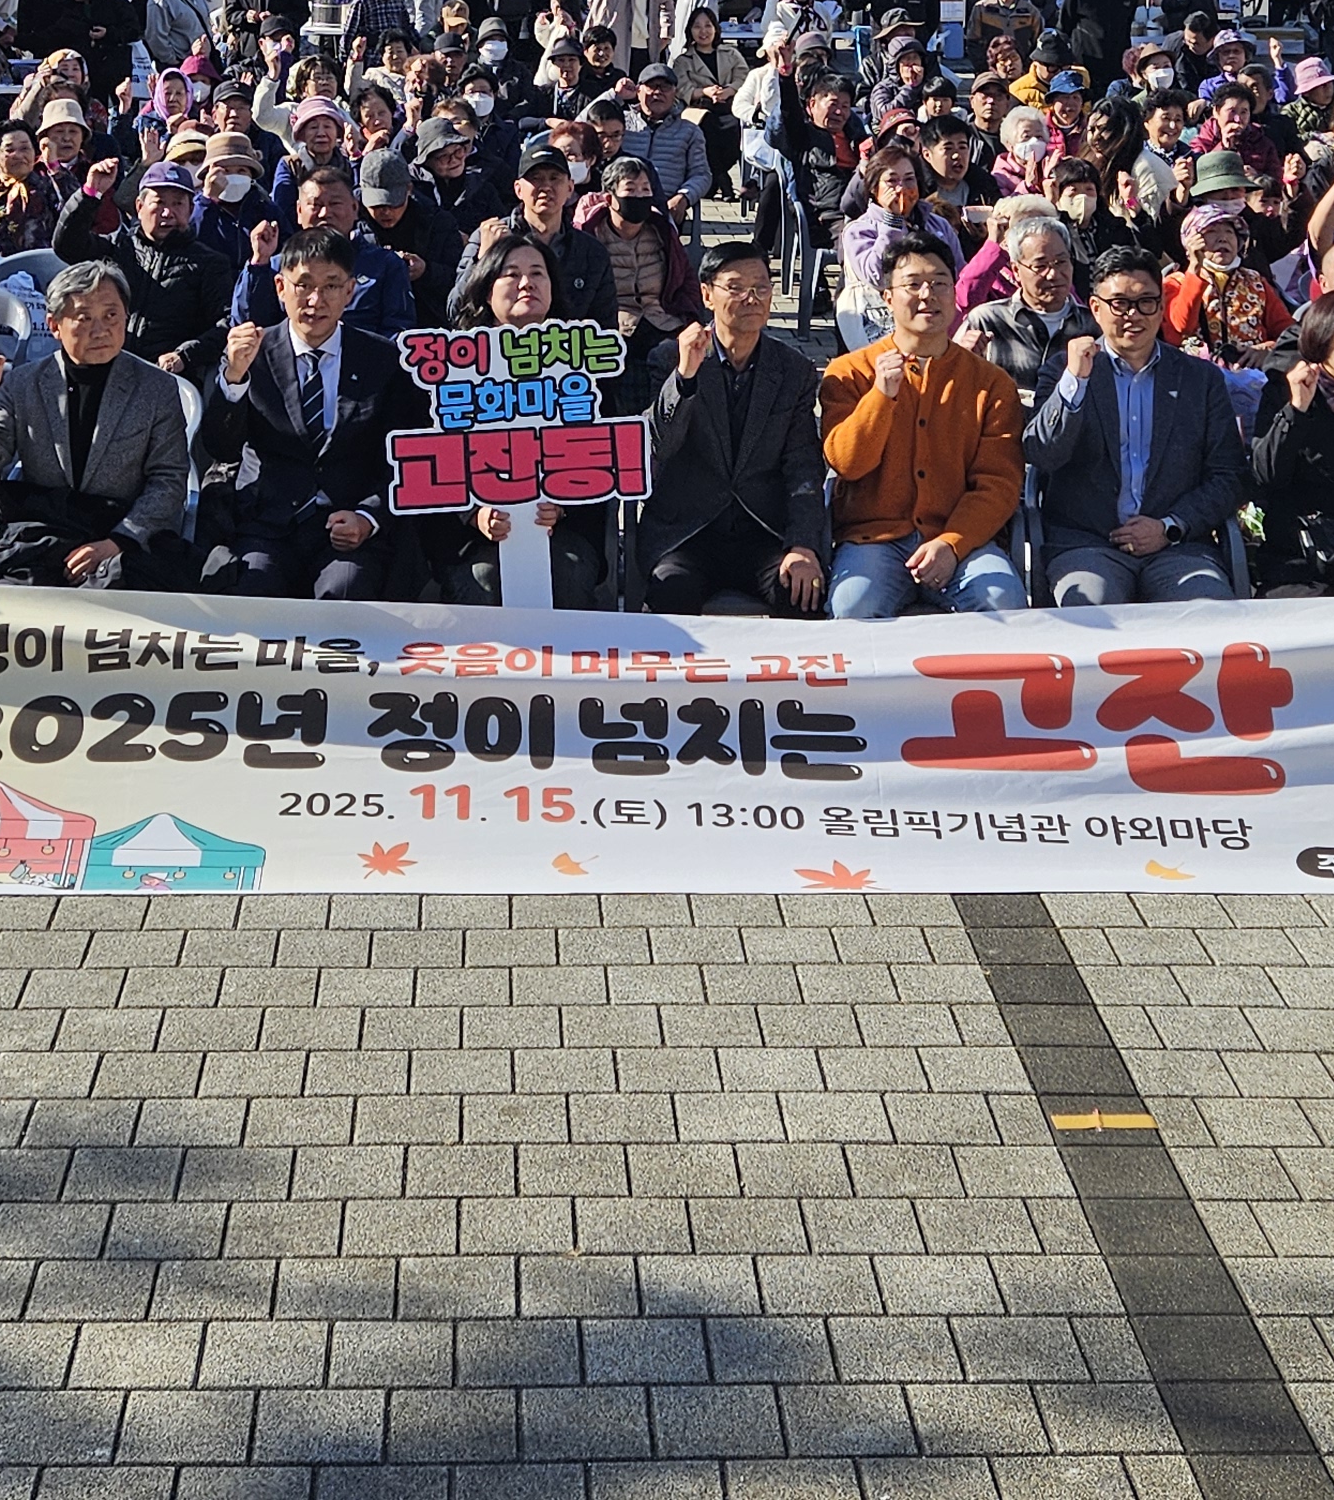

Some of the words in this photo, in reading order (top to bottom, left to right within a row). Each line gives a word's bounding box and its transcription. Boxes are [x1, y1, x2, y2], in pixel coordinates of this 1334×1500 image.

[404, 332, 490, 383] 정이
[501, 325, 620, 377] 넘치는
[437, 374, 595, 429] 문화마을
[392, 422, 646, 510] 고잔동!
[83, 628, 244, 674] 넘치는
[255, 635, 381, 677] 마을,
[396, 641, 554, 678] 웃음이
[571, 647, 731, 683] 머무는
[745, 652, 853, 688] 고잔
[367, 691, 556, 773] 정이
[578, 696, 869, 781] 넘치는
[900, 641, 1295, 797] 고잔
[278, 792, 395, 819] 2025.
[409, 784, 488, 822] 11.
[687, 802, 805, 830] 13:00
[818, 806, 1072, 845] 올림픽기념관
[1084, 815, 1253, 851] 야외마당
